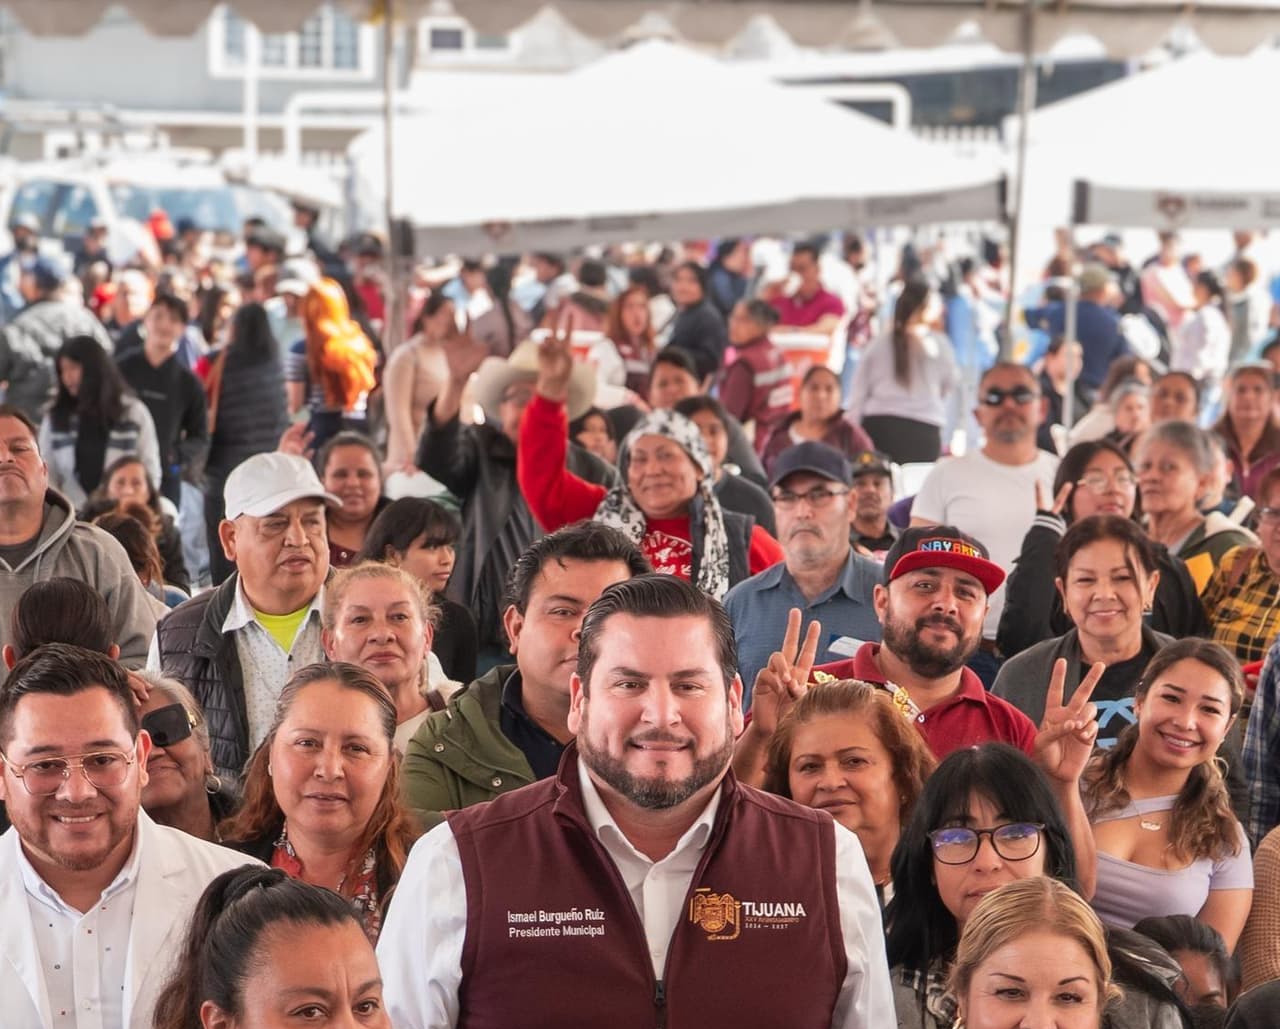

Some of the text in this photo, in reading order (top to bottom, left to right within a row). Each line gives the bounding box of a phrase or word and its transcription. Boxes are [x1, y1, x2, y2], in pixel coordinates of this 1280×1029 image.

[507, 907, 606, 925] Ismael Burgueño Ruiz
[741, 901, 807, 917] TIJUANA
[508, 924, 606, 938] Presidente Municipal
